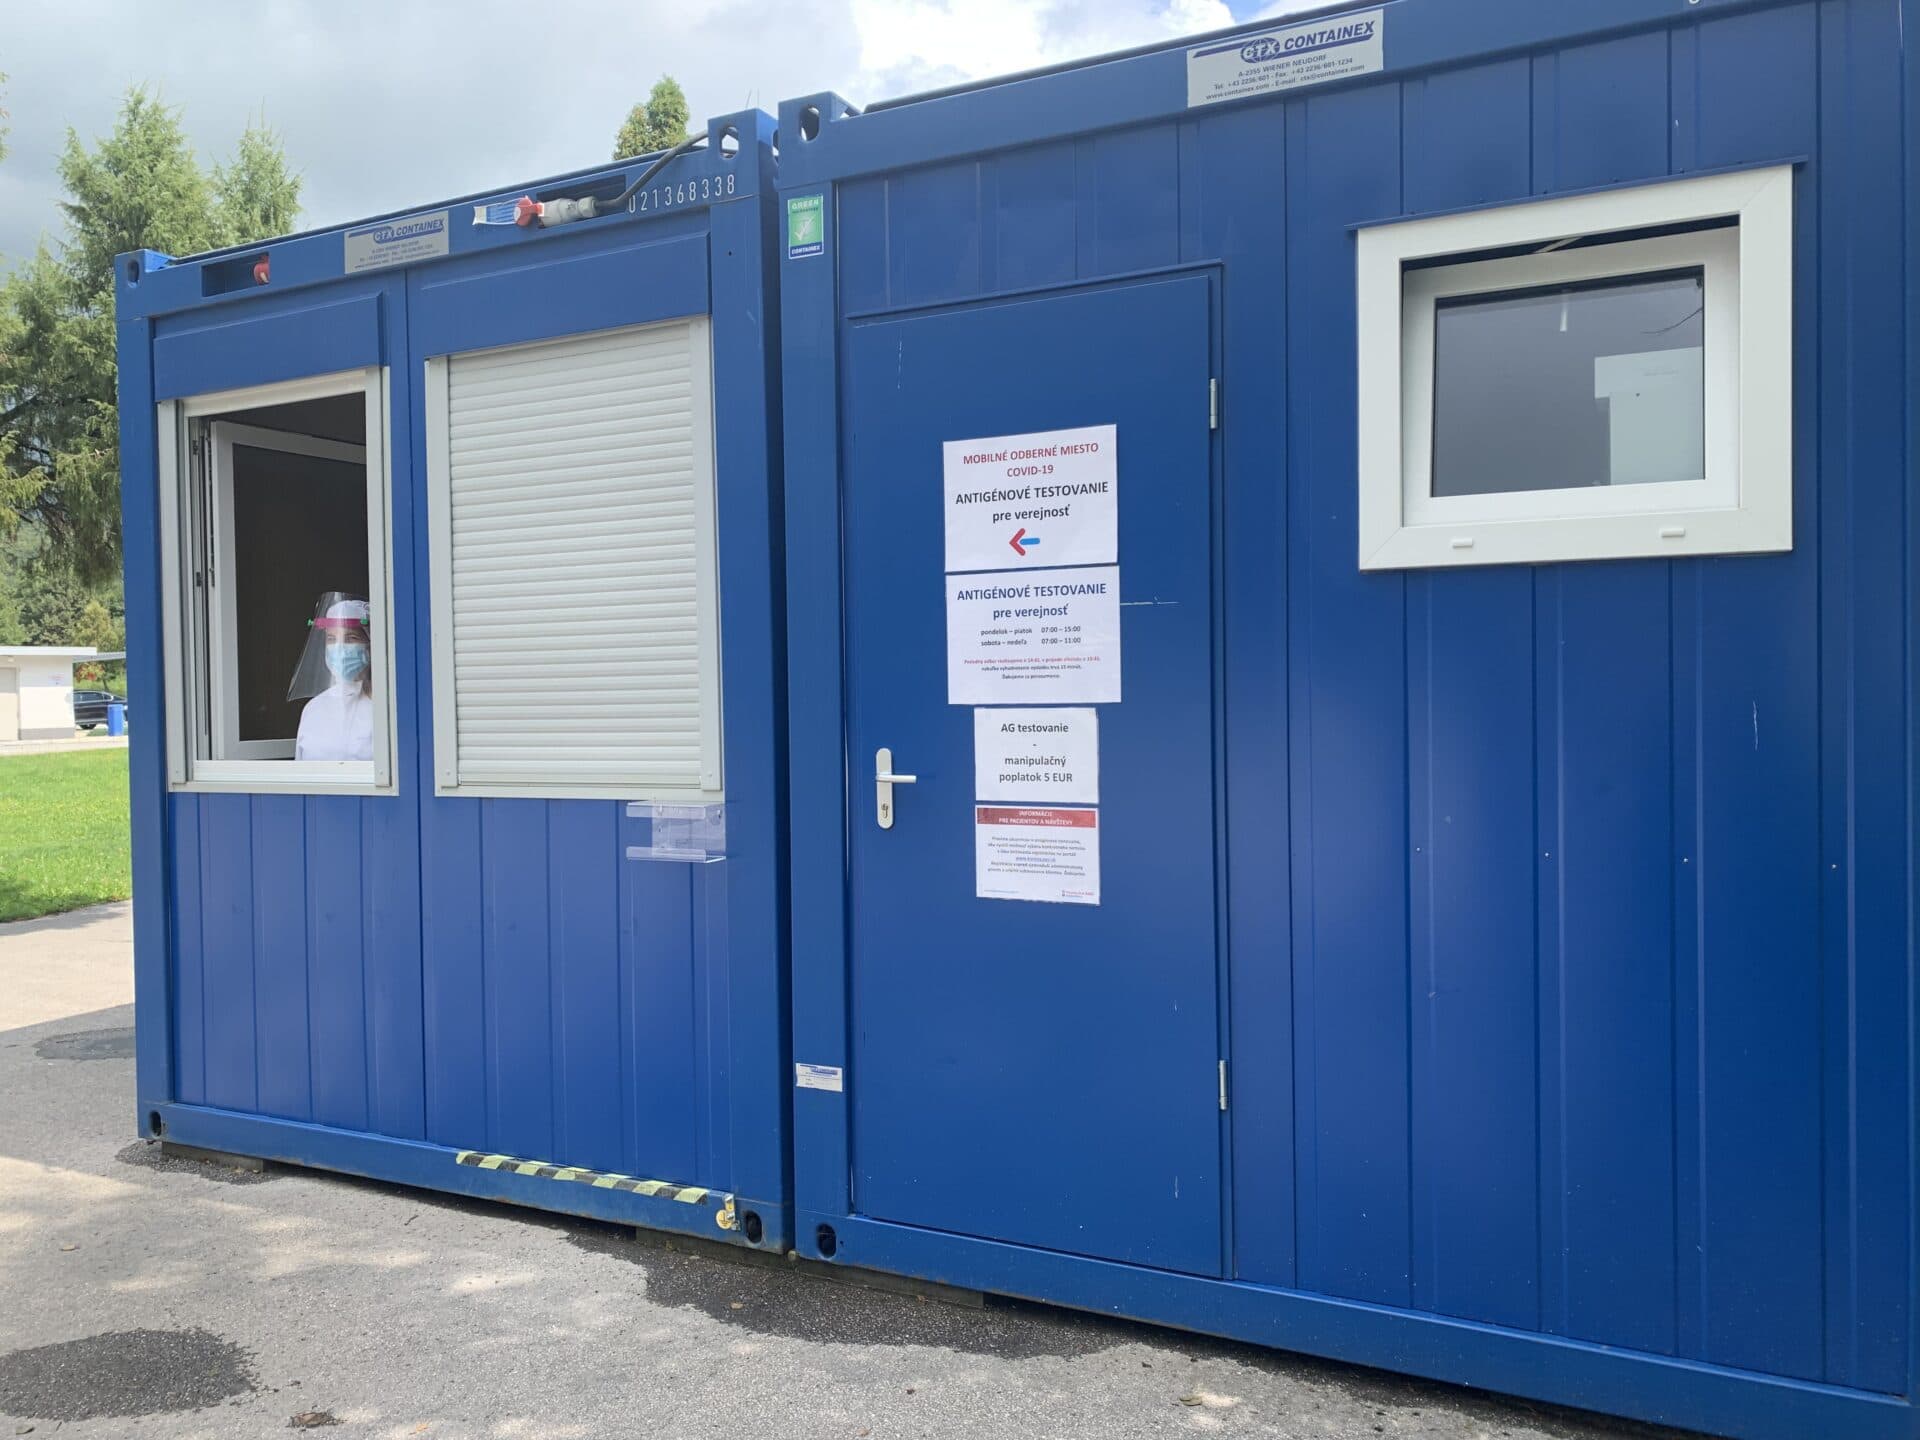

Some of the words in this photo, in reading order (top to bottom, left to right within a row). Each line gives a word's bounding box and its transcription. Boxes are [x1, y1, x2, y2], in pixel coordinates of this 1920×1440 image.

[1284, 20, 1375, 50] CONTAINEX
[1263, 61, 1291, 74] WIENER
[1292, 54, 1327, 67] NEUDORF
[628, 174, 735, 214] 021368338
[396, 218, 445, 236] CONTAINEX
[963, 449, 1008, 465] MOBILNÉ
[1011, 445, 1057, 461] ODBERNÉ
[1061, 442, 1099, 456] MIESTO
[1007, 464, 1054, 477] COVID-19
[955, 485, 1031, 505] ANTIGÉNOVÉ
[1034, 481, 1109, 499] TESTOVANIE
[992, 510, 1012, 524] pre
[1015, 504, 1070, 521] verejnosť
[957, 584, 1031, 601] ANTIGÉNOVÉ
[1034, 583, 1107, 598] TESTOVANIE
[993, 607, 1012, 621] pre
[1015, 603, 1069, 619] verejnosť
[980, 628, 1008, 636] pondelok
[1014, 627, 1033, 635] piatok
[981, 638, 1001, 646] sobota
[1001, 723, 1015, 732] AG
[1018, 723, 1069, 733] testovanie
[1004, 756, 1067, 767] manipulačný
[999, 772, 1041, 783] poplatok
[1044, 773, 1050, 782] 5
[1053, 773, 1073, 782] EUR
